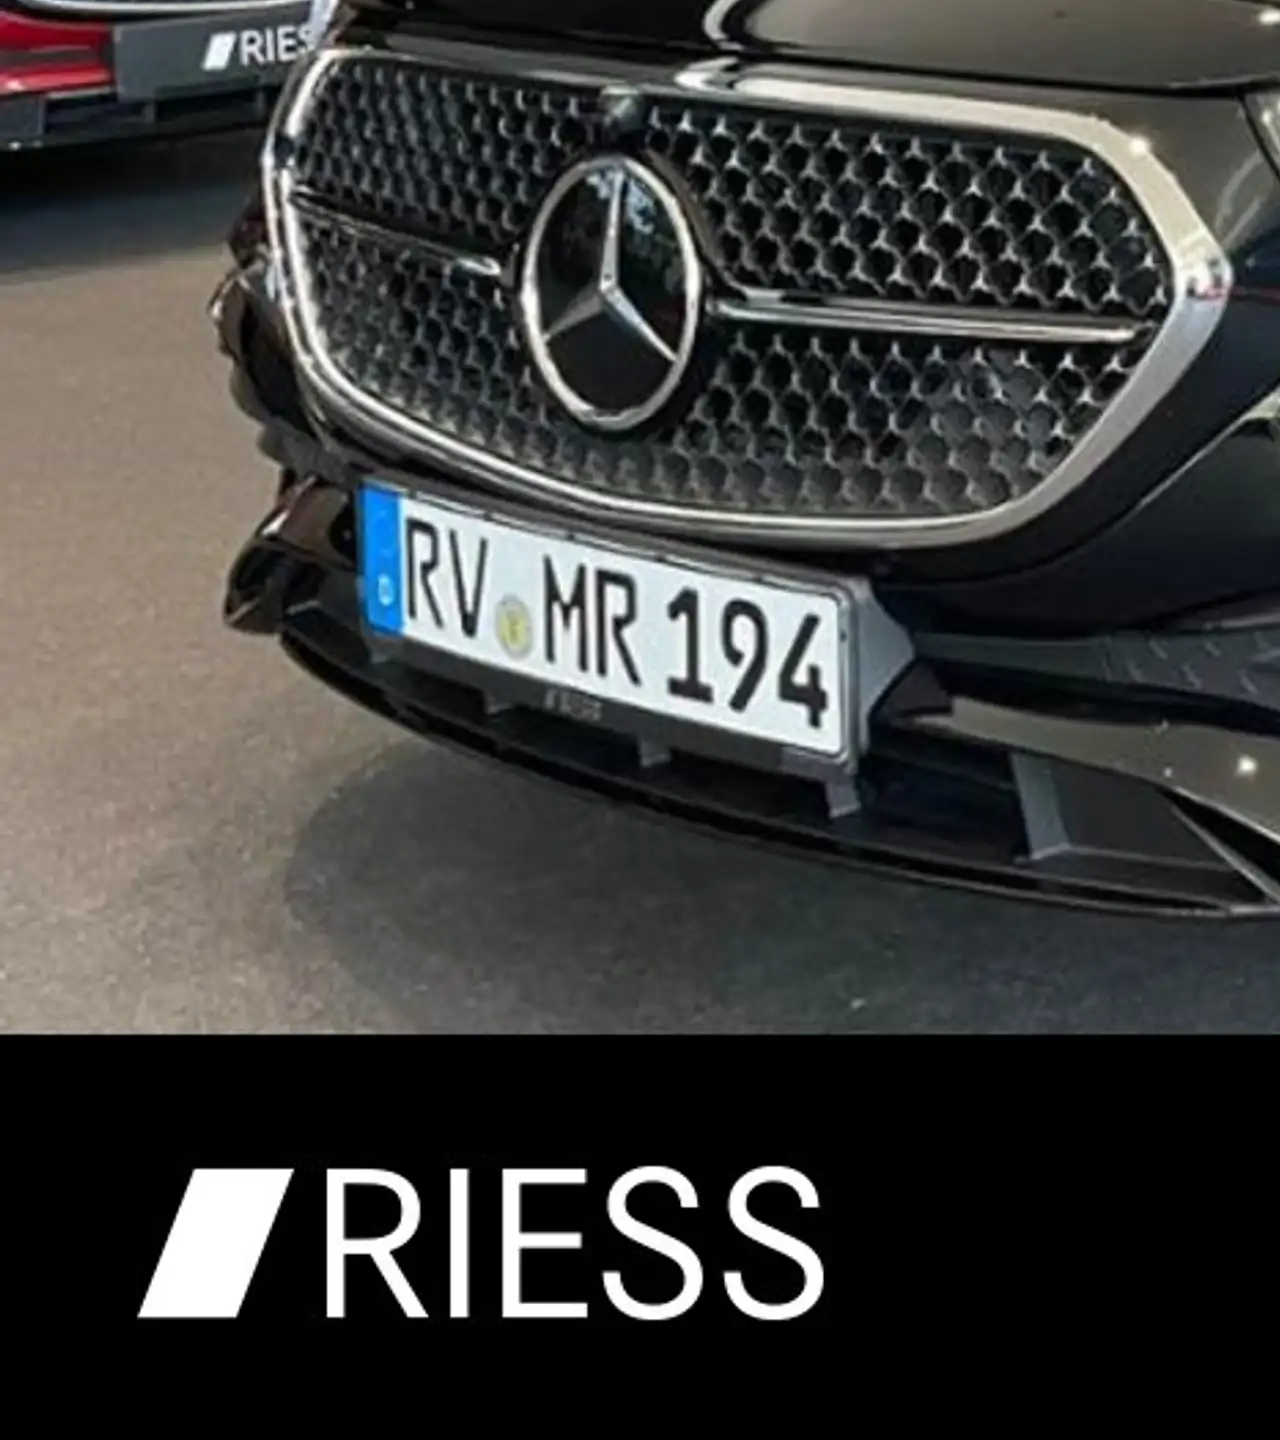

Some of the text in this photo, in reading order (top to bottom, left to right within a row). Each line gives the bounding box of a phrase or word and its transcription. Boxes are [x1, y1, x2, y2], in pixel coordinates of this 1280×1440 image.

[239, 24, 317, 67] RIES
[405, 516, 829, 729] RV MR 194
